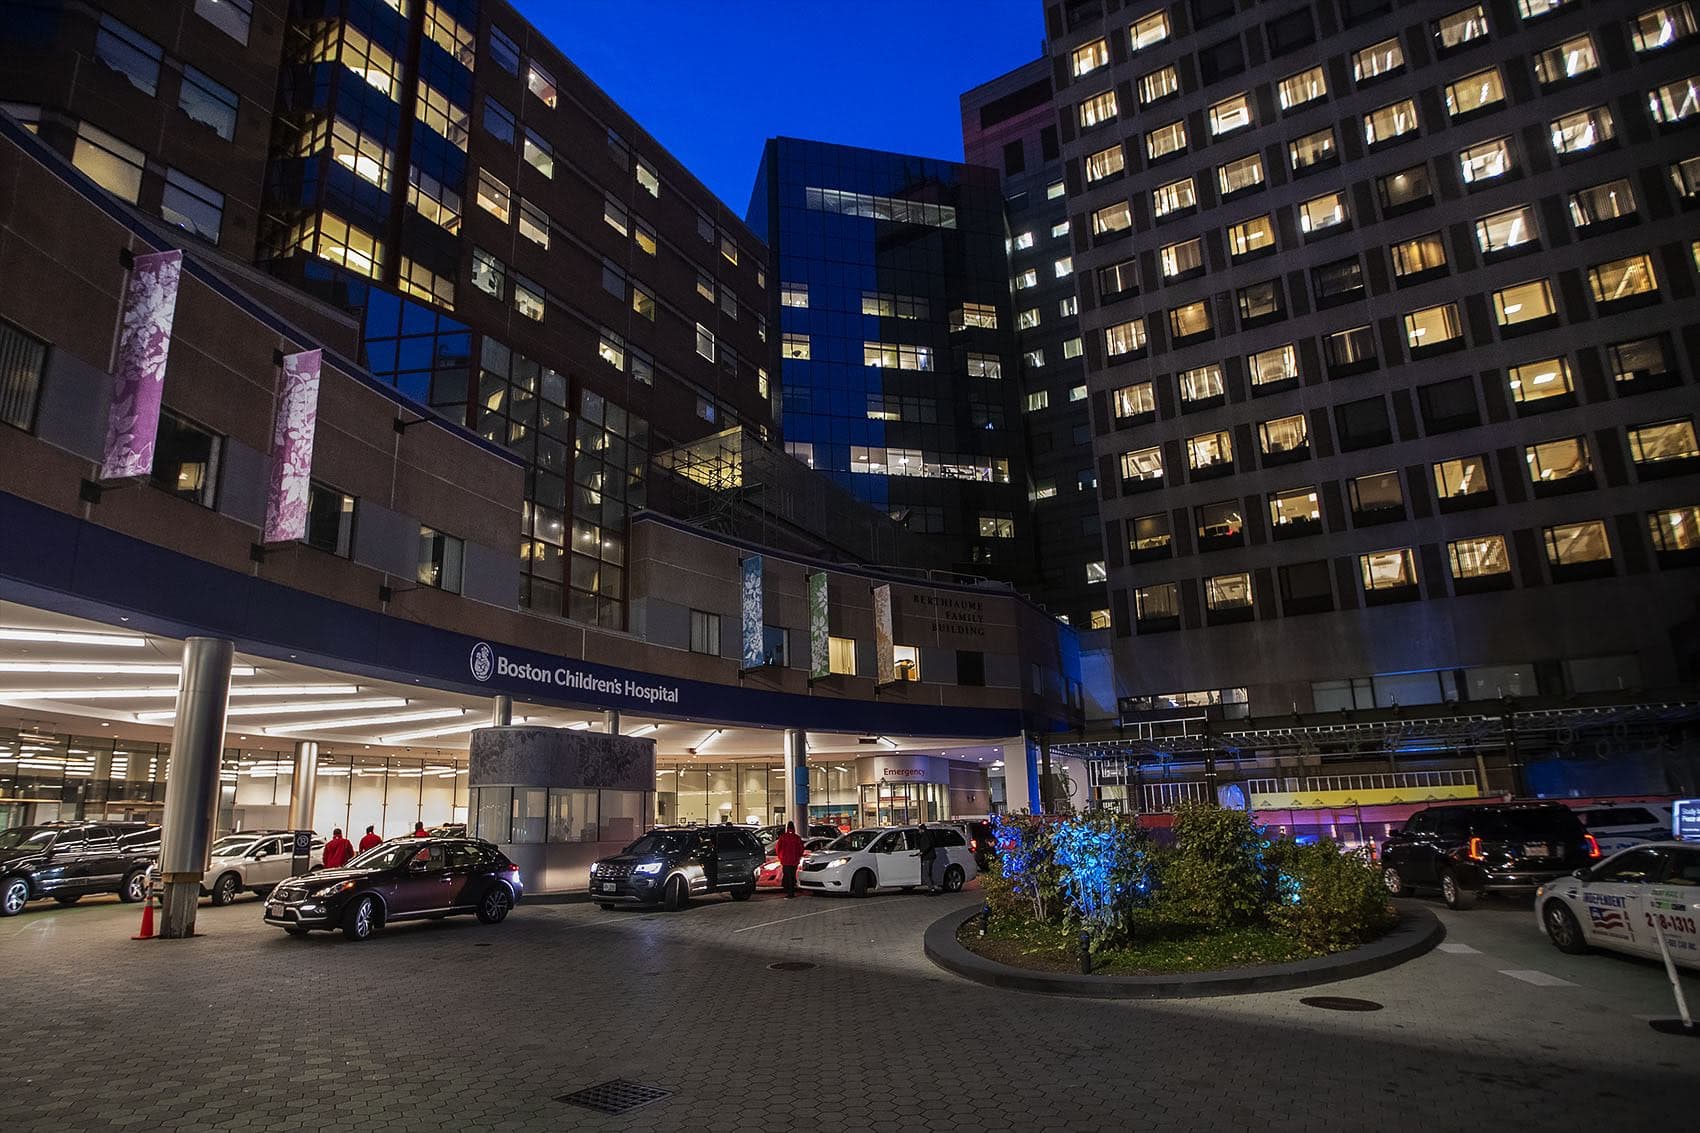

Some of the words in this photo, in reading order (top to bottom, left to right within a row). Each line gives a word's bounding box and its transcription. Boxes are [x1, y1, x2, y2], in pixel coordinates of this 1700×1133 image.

[913, 594, 983, 610] BERTHIAUME
[945, 611, 984, 623] FAMILY
[932, 623, 985, 636] BUILDING
[497, 656, 552, 684] Boston
[554, 668, 623, 695] Children's
[624, 680, 679, 704] Hospital
[883, 767, 926, 777] Emergency
[1645, 912, 1697, 935] 28-1313
